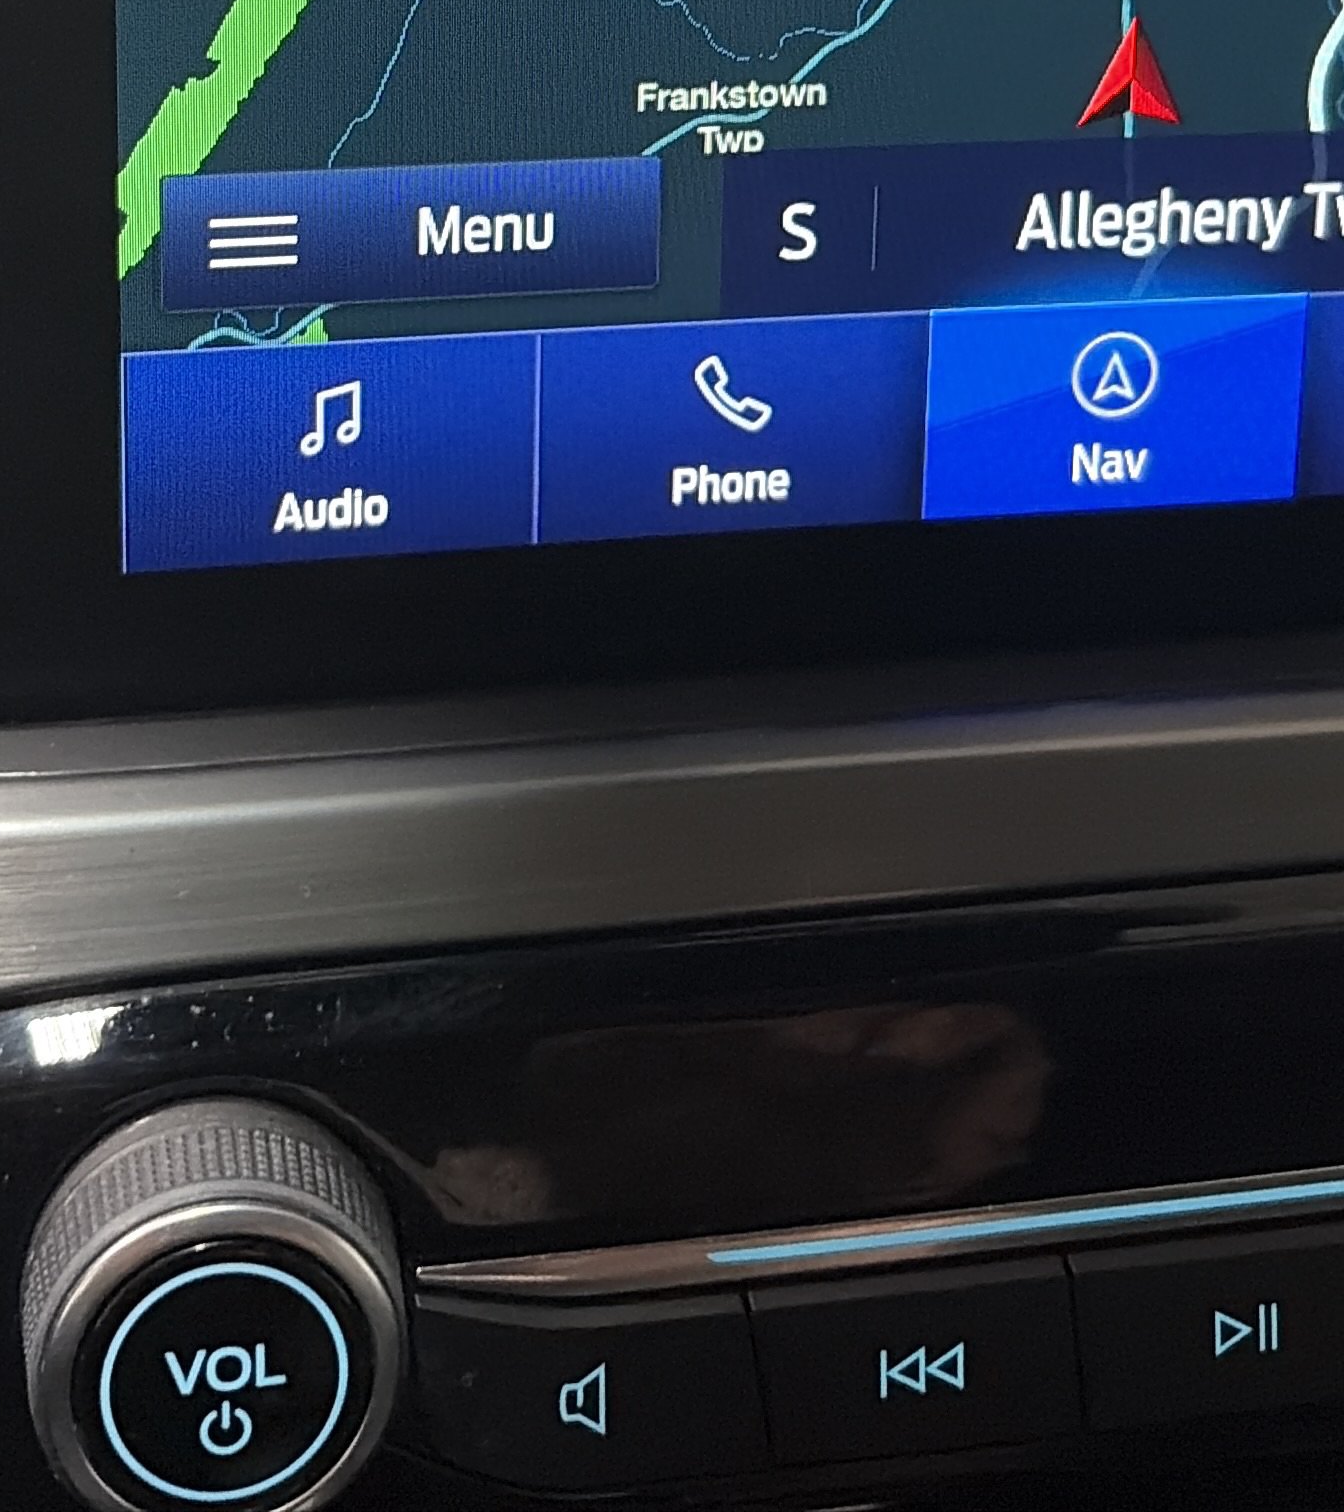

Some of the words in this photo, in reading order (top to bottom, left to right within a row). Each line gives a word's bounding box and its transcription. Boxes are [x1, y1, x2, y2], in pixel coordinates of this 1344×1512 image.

[637, 80, 827, 113] Frankstown
[417, 205, 554, 256] Menu
[778, 202, 817, 261] S
[1015, 186, 1294, 257] Allegheny
[671, 464, 791, 506] Phone
[1071, 442, 1148, 483] Nav
[273, 487, 389, 533] Audio
[164, 1343, 287, 1396] VOL
